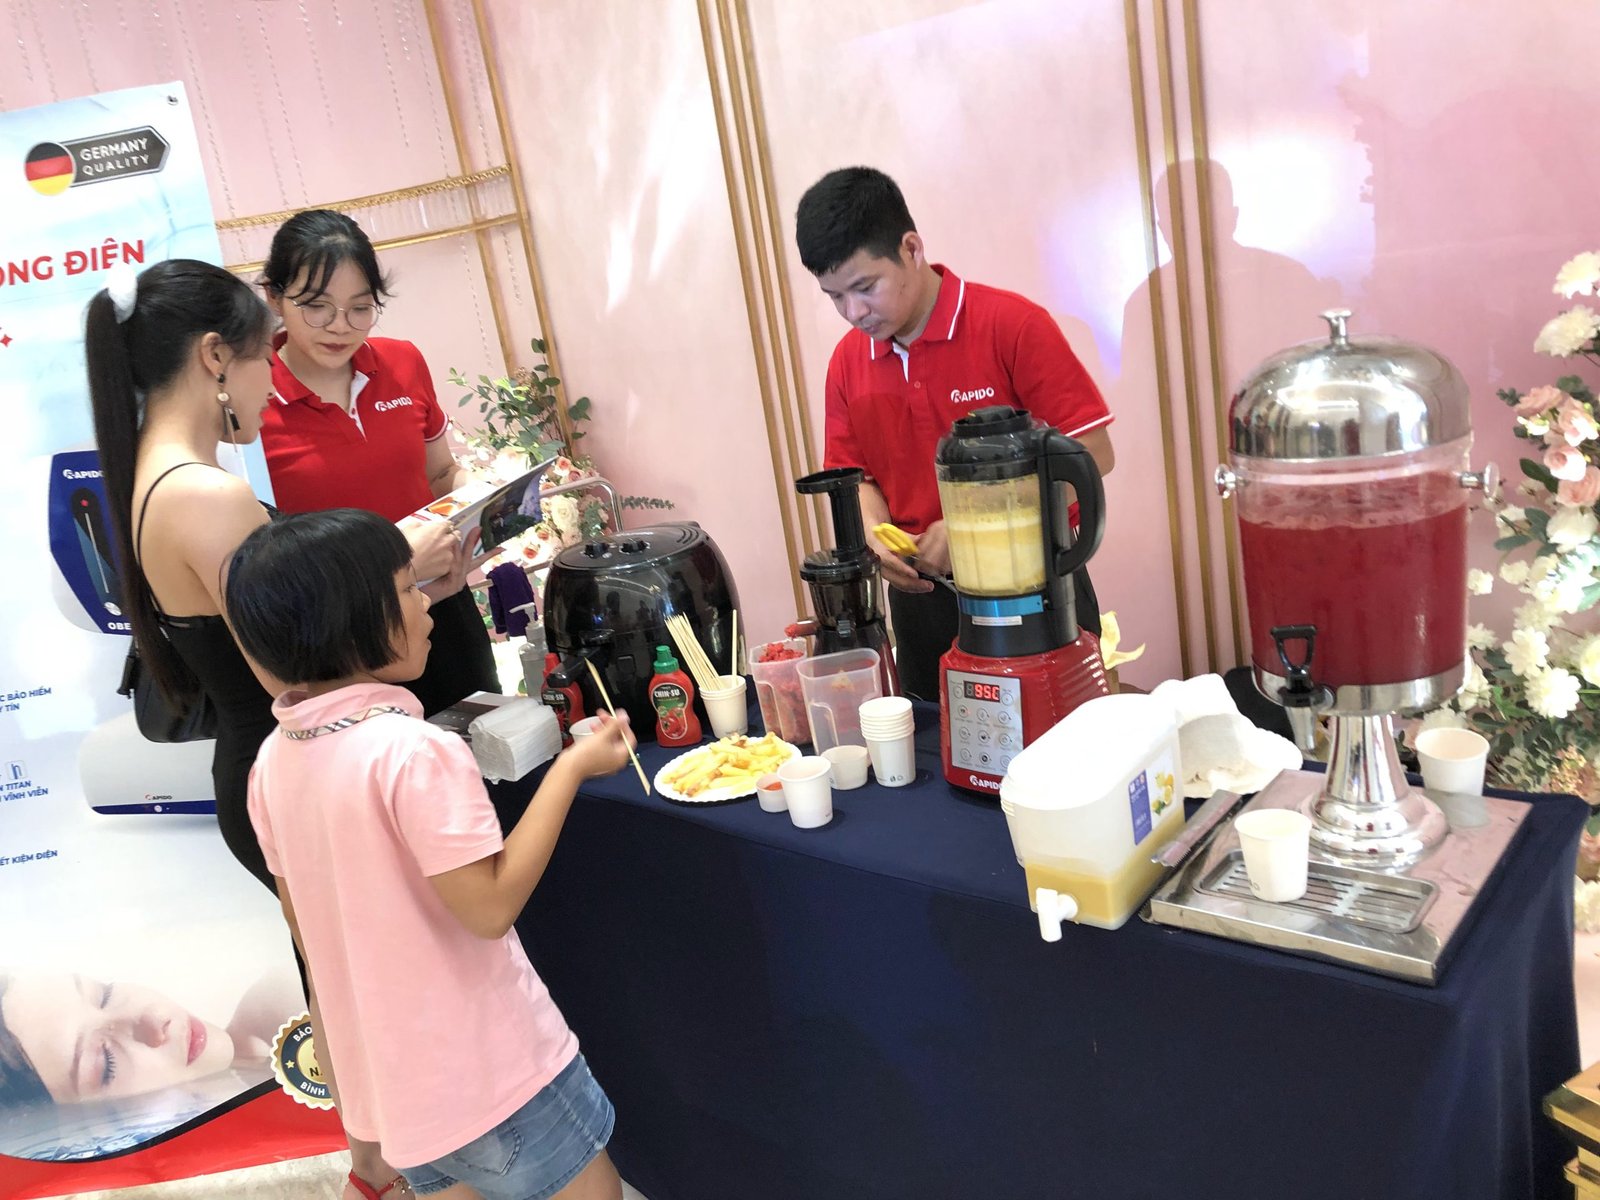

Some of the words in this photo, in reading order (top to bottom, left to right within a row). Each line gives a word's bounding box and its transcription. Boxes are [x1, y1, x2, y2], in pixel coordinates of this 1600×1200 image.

[80, 138, 148, 161] GERMANY
[82, 154, 149, 176] QUALITY
[0, 256, 53, 288] NG
[950, 387, 995, 403] RAPIDO
[374, 396, 413, 412] RAPIDO
[5, 780, 31, 791] TITAN
[293, 1026, 313, 1042] BẢO
[300, 1081, 326, 1096] BÌNH
